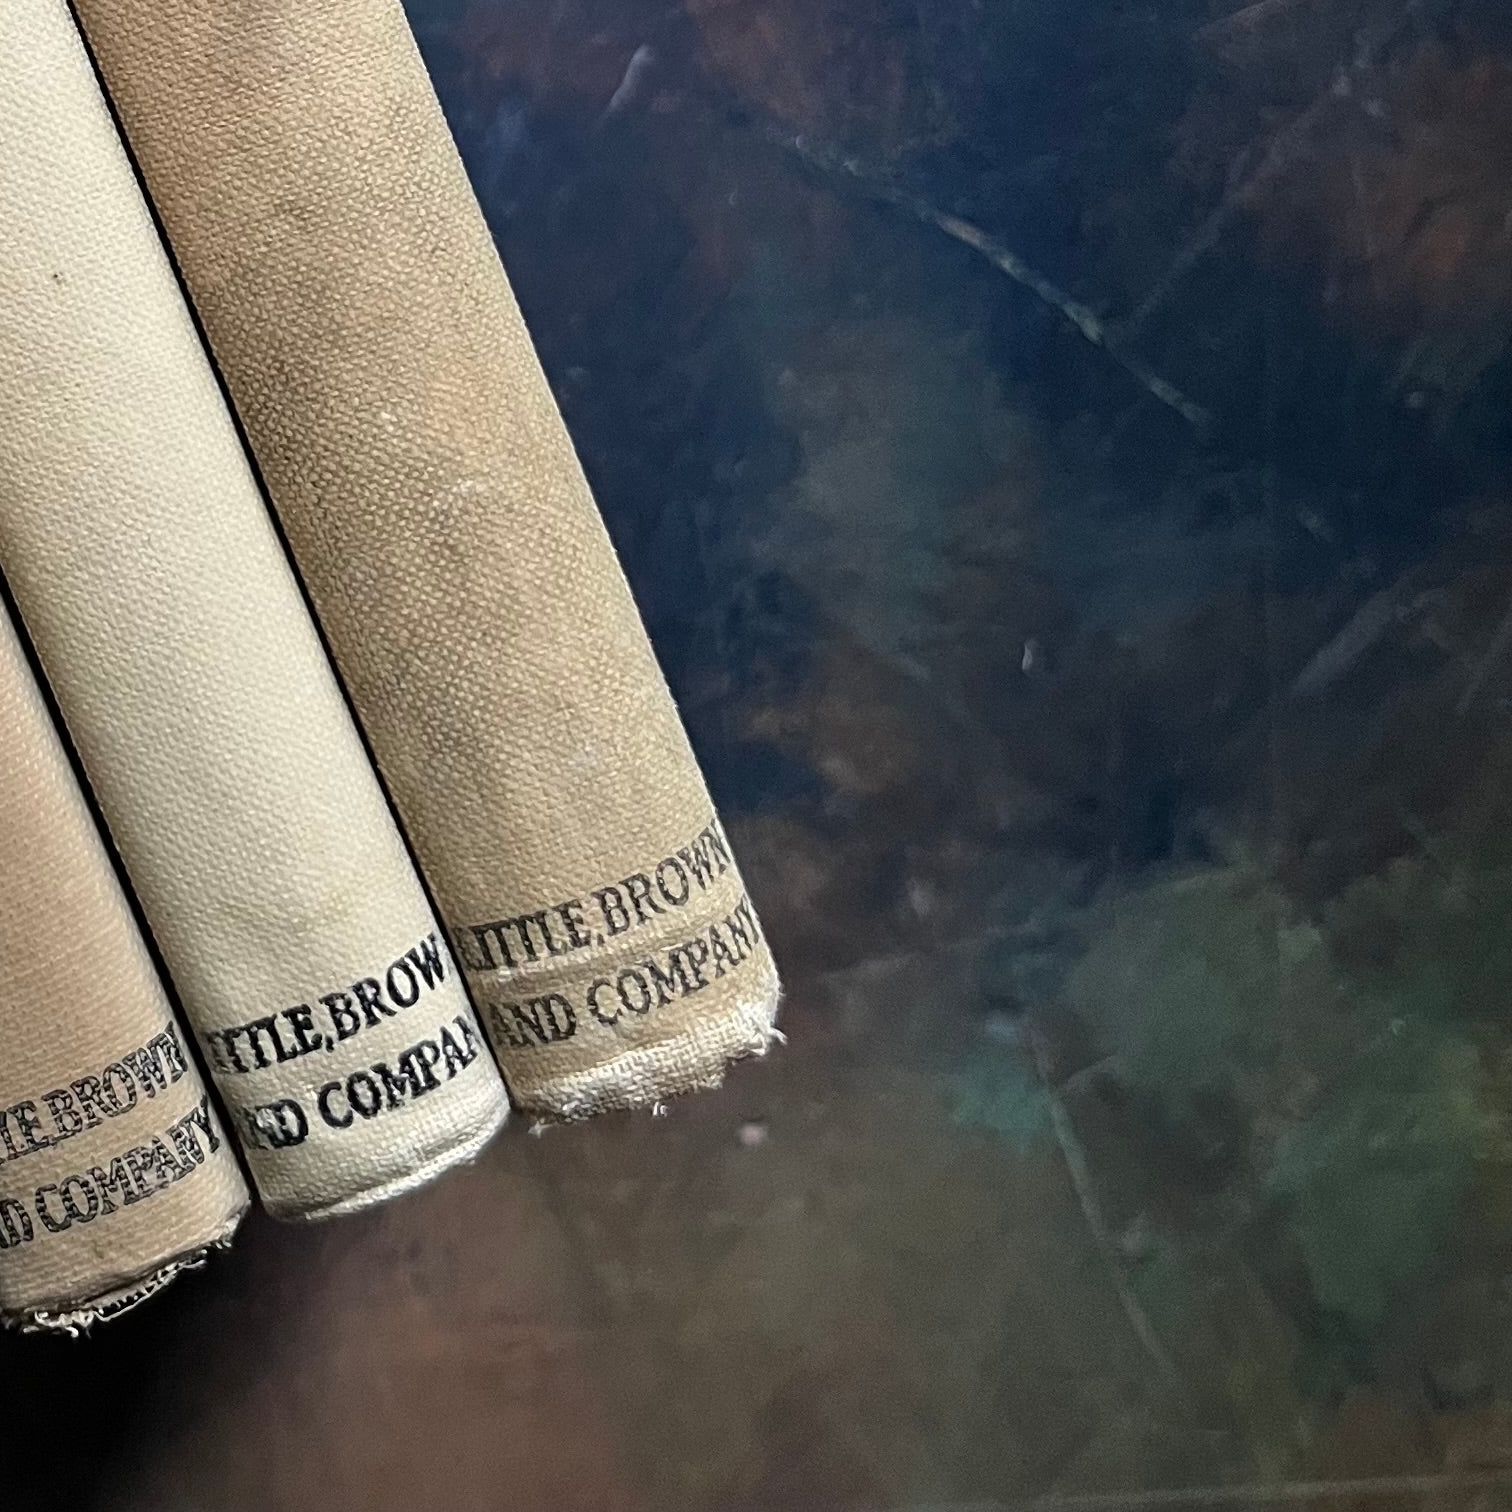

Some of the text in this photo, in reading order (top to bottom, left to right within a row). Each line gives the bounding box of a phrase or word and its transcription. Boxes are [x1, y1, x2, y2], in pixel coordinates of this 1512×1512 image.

[202, 933, 445, 1075] TTLE, BROW
[488, 993, 578, 1048] AND
[42, 1021, 187, 1141] BROWN
[317, 1014, 478, 1129] COMPA
[36, 1094, 219, 1233] COMPANY
